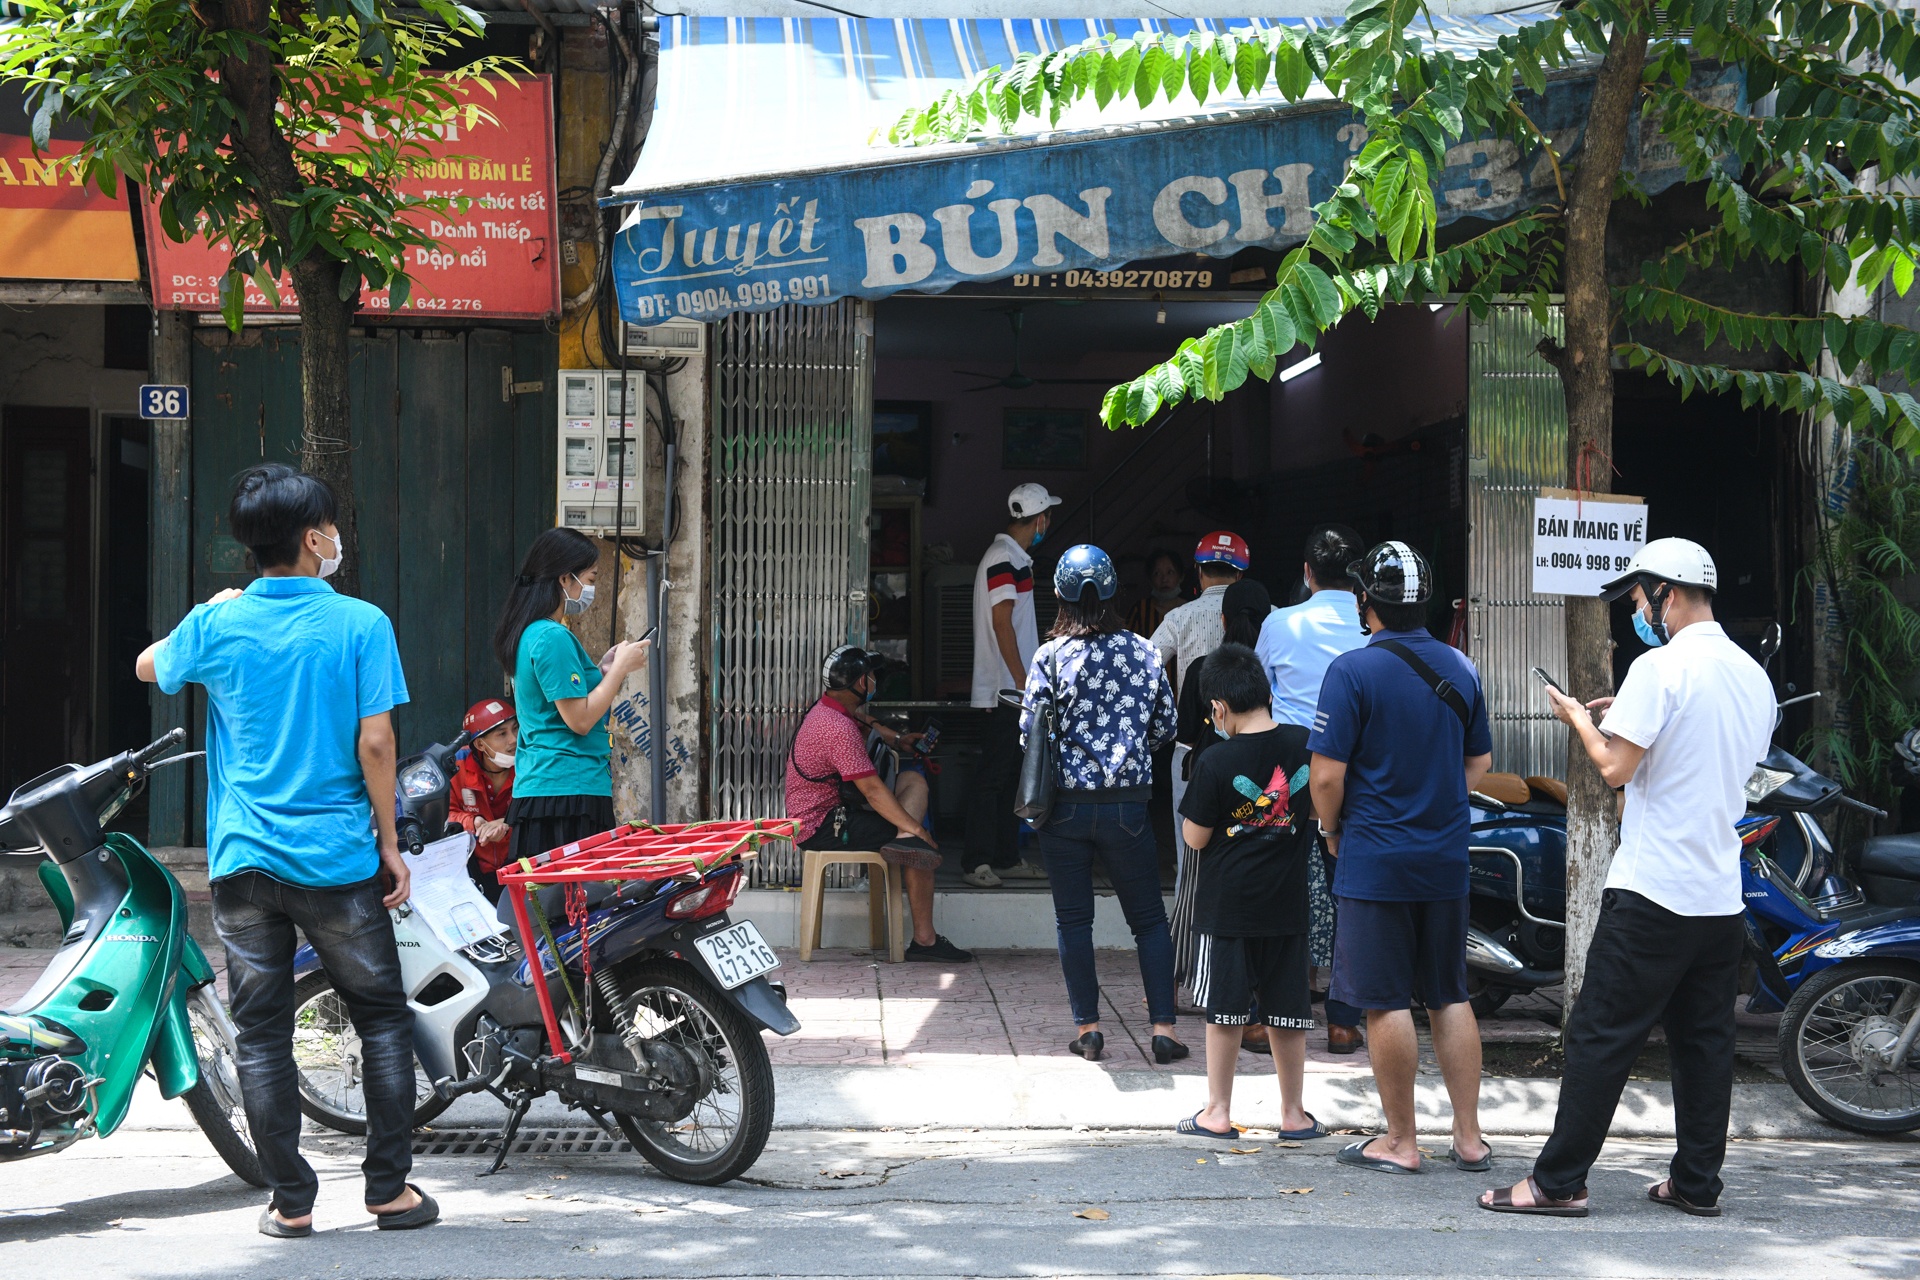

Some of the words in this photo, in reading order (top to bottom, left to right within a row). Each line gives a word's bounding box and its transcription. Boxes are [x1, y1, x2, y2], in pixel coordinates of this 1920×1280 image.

[469, 159, 506, 181] BÁN
[512, 157, 532, 182] LẺ
[520, 190, 546, 211] tết
[430, 220, 478, 239] Danh
[482, 219, 532, 244] Thiếp
[625, 195, 826, 277] Tuyết
[853, 179, 1113, 289] BÚN
[416, 247, 455, 271] Dập
[460, 245, 487, 267] nổi
[172, 275, 203, 287] ĐC:
[1065, 269, 1213, 289] 0439270879
[416, 298, 447, 311] 642
[452, 299, 483, 311] 276
[637, 293, 672, 319] ĐT:
[676, 273, 831, 316] 0904.998.991
[148, 390, 180, 414] 36
[1537, 514, 1569, 538] BÁN
[1572, 519, 1619, 541] MANG
[1623, 517, 1643, 542] VỀ
[1536, 556, 1549, 568] LH:
[1551, 552, 1582, 570] 0904
[1586, 554, 1611, 572] 998
[1614, 556, 1632, 572] 99
[706, 919, 725, 929] HONDA
[105, 934, 159, 942] HONDA
[706, 925, 756, 960] 29-D2
[718, 945, 775, 984] 473.16
